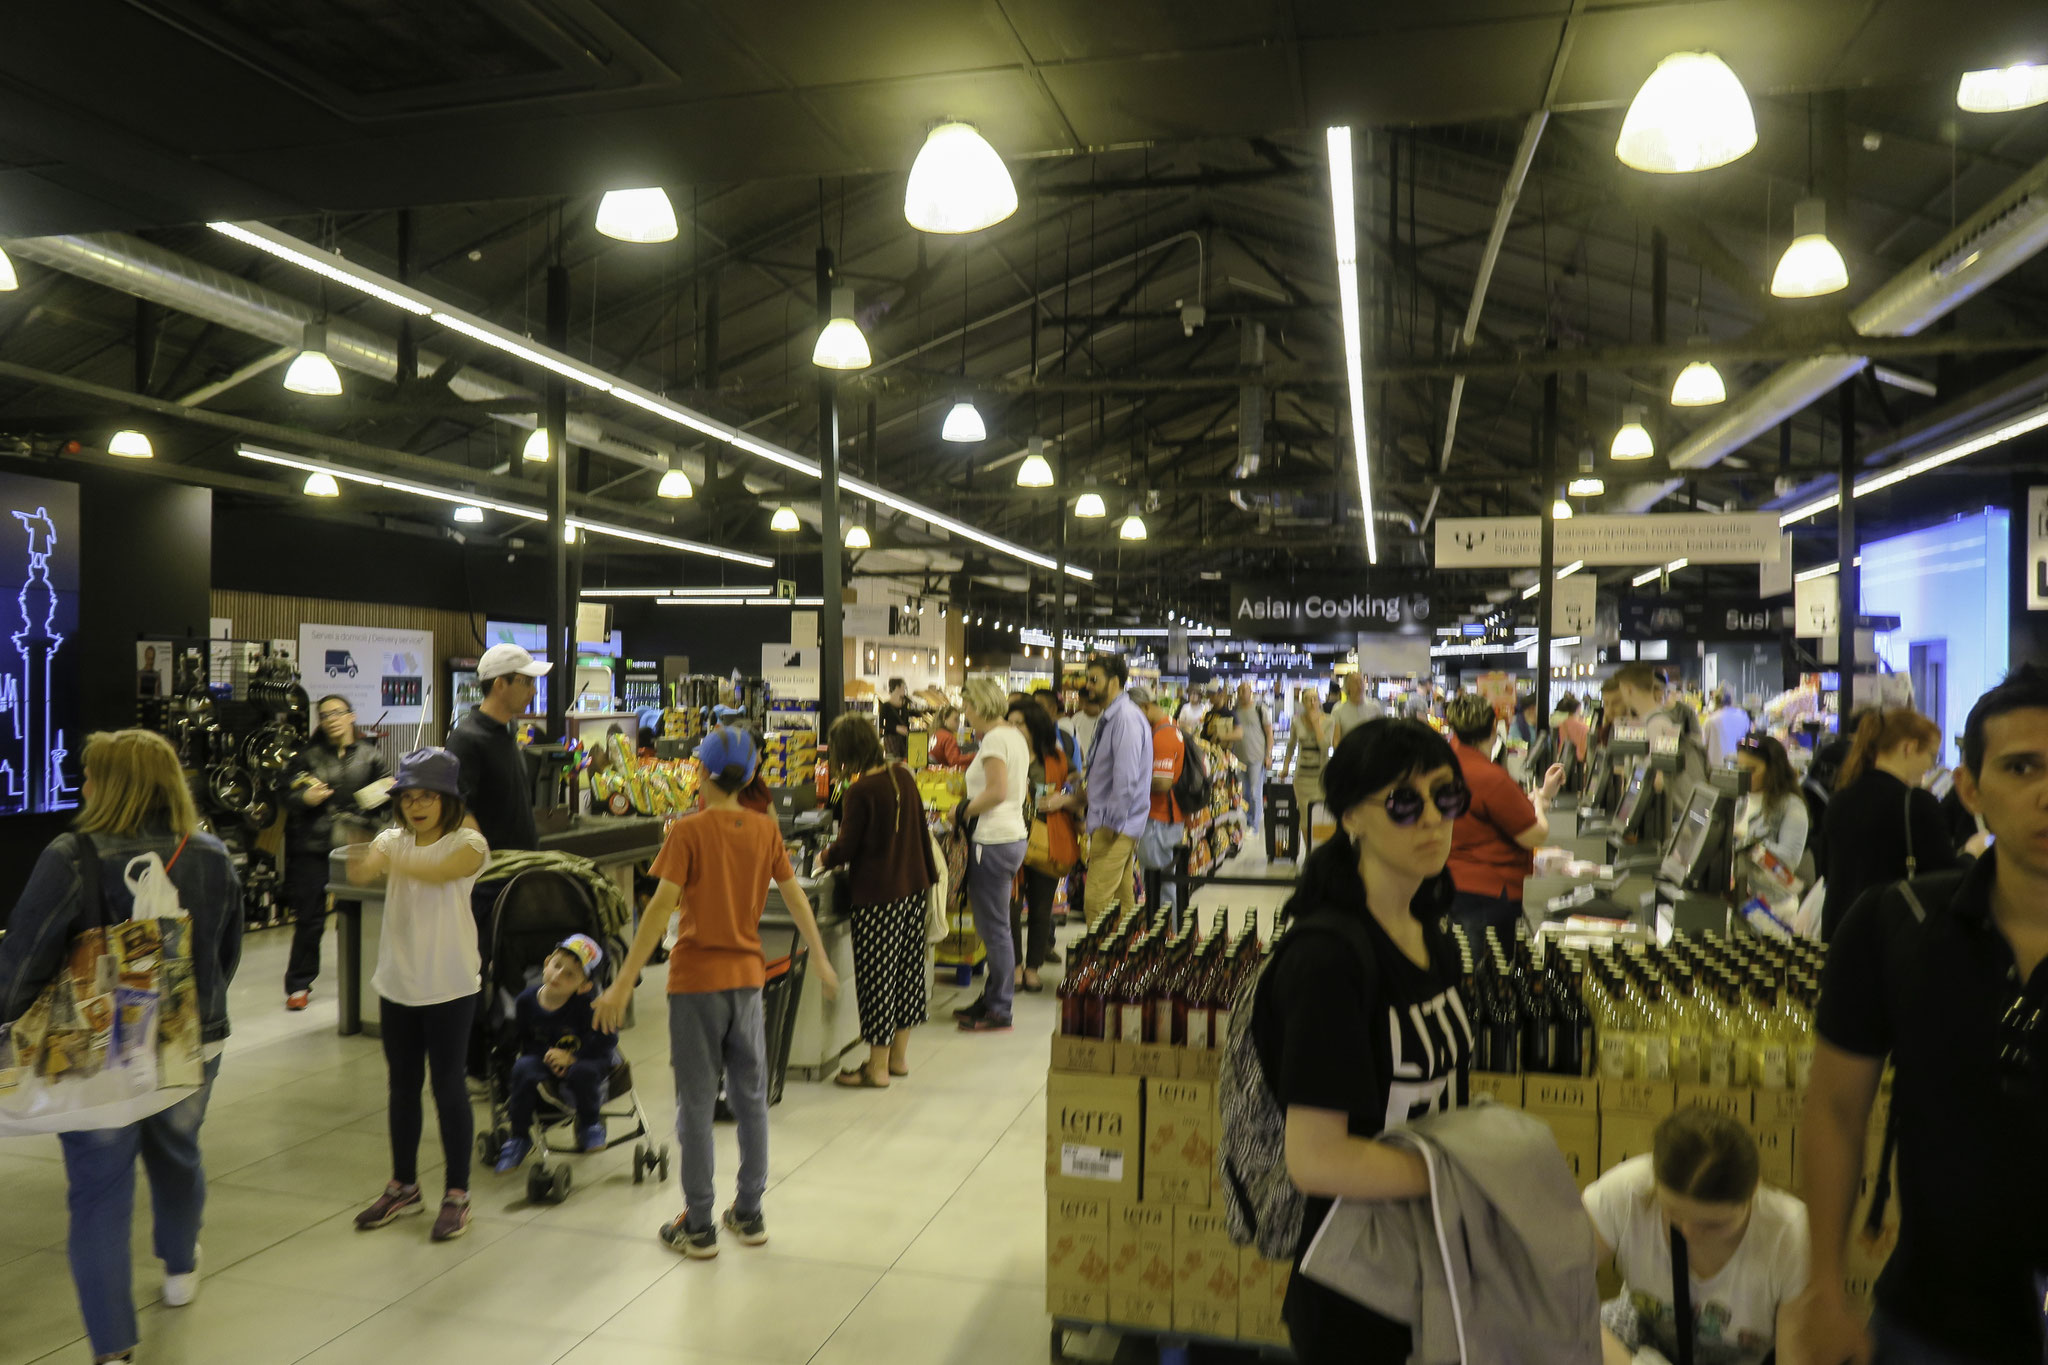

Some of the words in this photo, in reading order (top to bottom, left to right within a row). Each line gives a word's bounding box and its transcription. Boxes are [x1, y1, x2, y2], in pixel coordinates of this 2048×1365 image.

[1237, 595, 1300, 620] Asian
[1305, 593, 1401, 623] Cooking
[1158, 1082, 1198, 1102] terra
[1060, 1105, 1123, 1137] terra
[1060, 1199, 1099, 1219] terra
[1123, 1206, 1163, 1226] terra
